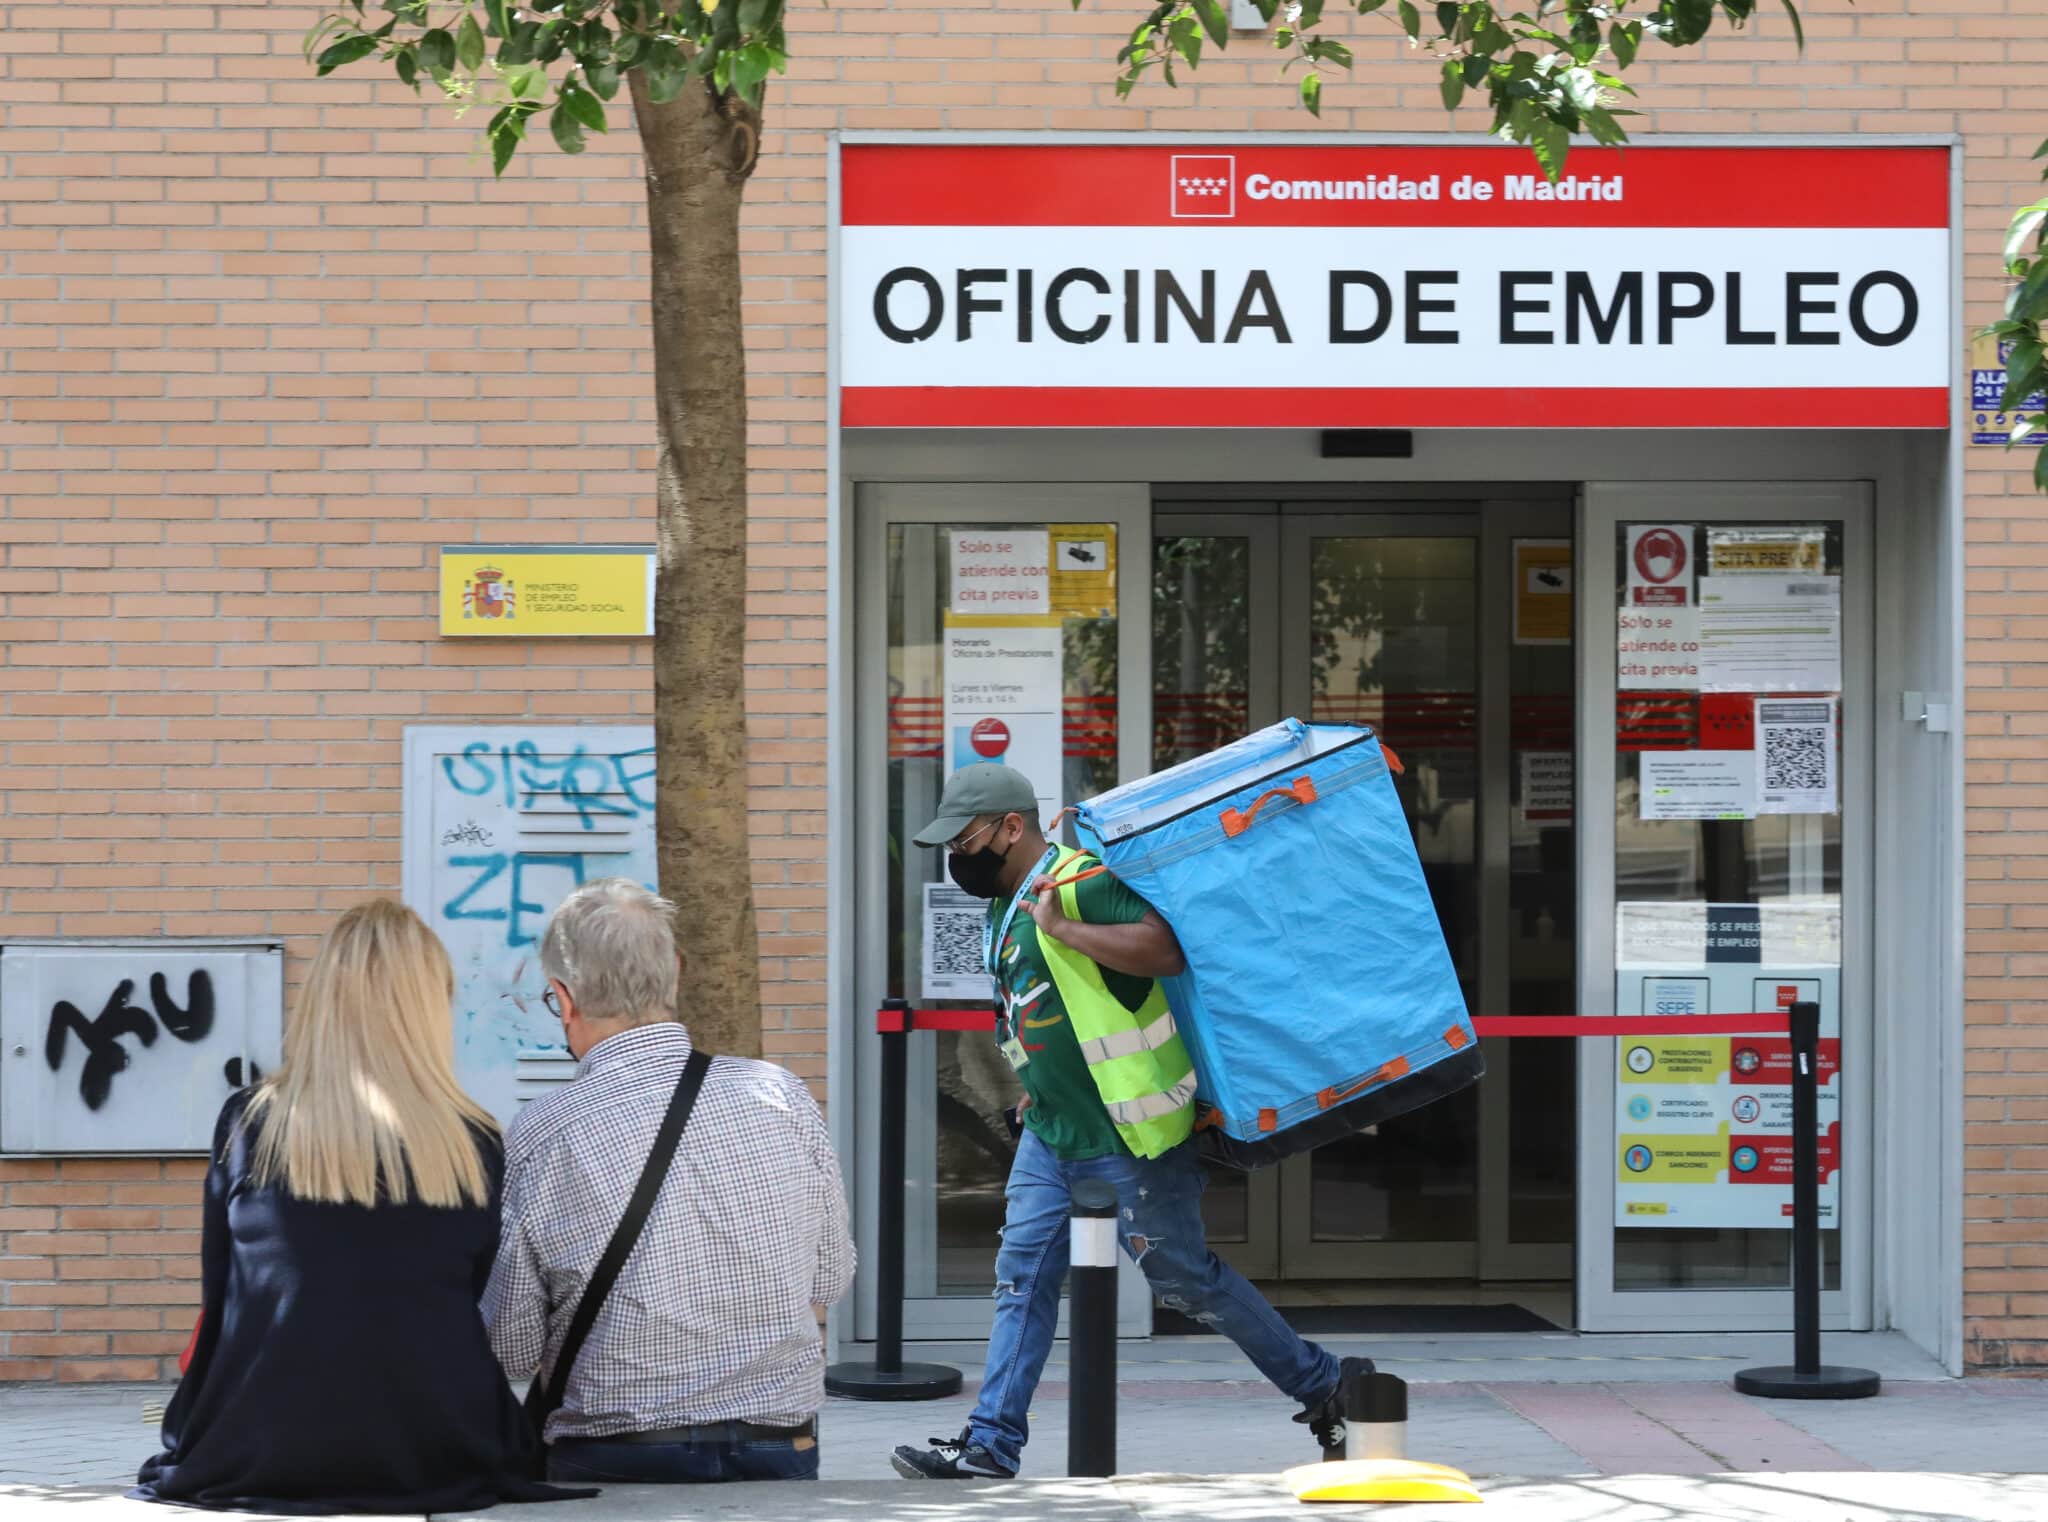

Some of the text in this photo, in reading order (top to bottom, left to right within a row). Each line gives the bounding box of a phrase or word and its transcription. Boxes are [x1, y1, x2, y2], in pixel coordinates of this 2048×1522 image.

[1245, 174, 1623, 201] Comunidad de Madrid
[873, 267, 1918, 346] OFICINA DE EMPLEO
[958, 540, 1013, 553] Solo se
[958, 565, 1048, 577] atiende con
[525, 583, 577, 591] MINISTERIO
[525, 593, 537, 601] DE
[958, 588, 1040, 603] cita previa
[534, 603, 588, 612] SEGURIDAD
[591, 603, 624, 612] SOCIAL
[1620, 617, 1672, 628] Solo se
[952, 638, 990, 647] Horario
[1620, 640, 1699, 652] atiende co
[952, 649, 983, 658] Oficina
[986, 649, 996, 658] de
[1620, 664, 1697, 677] cita previa
[1719, 922, 1733, 931] SE
[1656, 1001, 1695, 1014] SEPE
